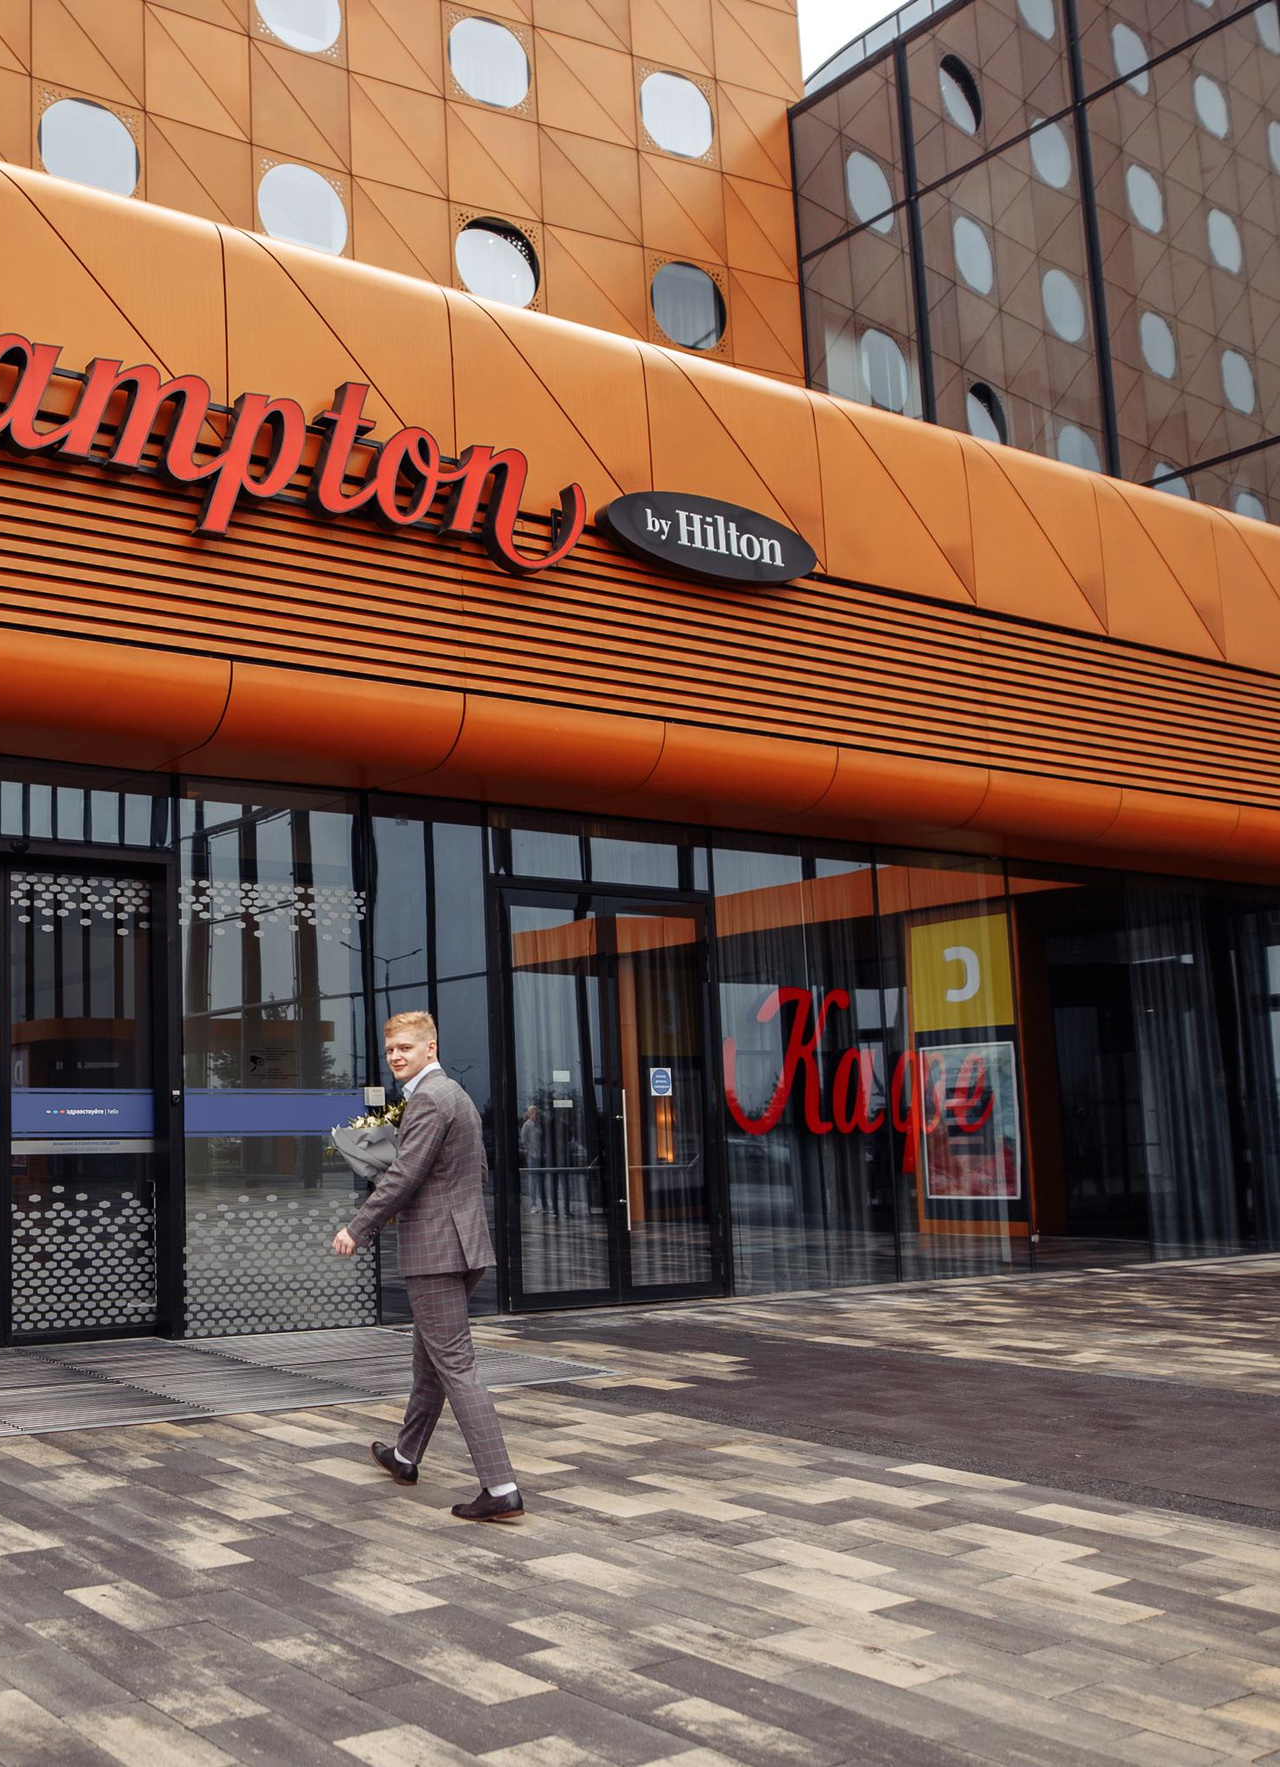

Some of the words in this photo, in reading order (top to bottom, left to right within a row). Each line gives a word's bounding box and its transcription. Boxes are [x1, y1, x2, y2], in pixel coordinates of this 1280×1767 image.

[645, 508, 671, 541] by
[675, 509, 785, 567] Hilton
[723, 986, 996, 1173] Кафе
